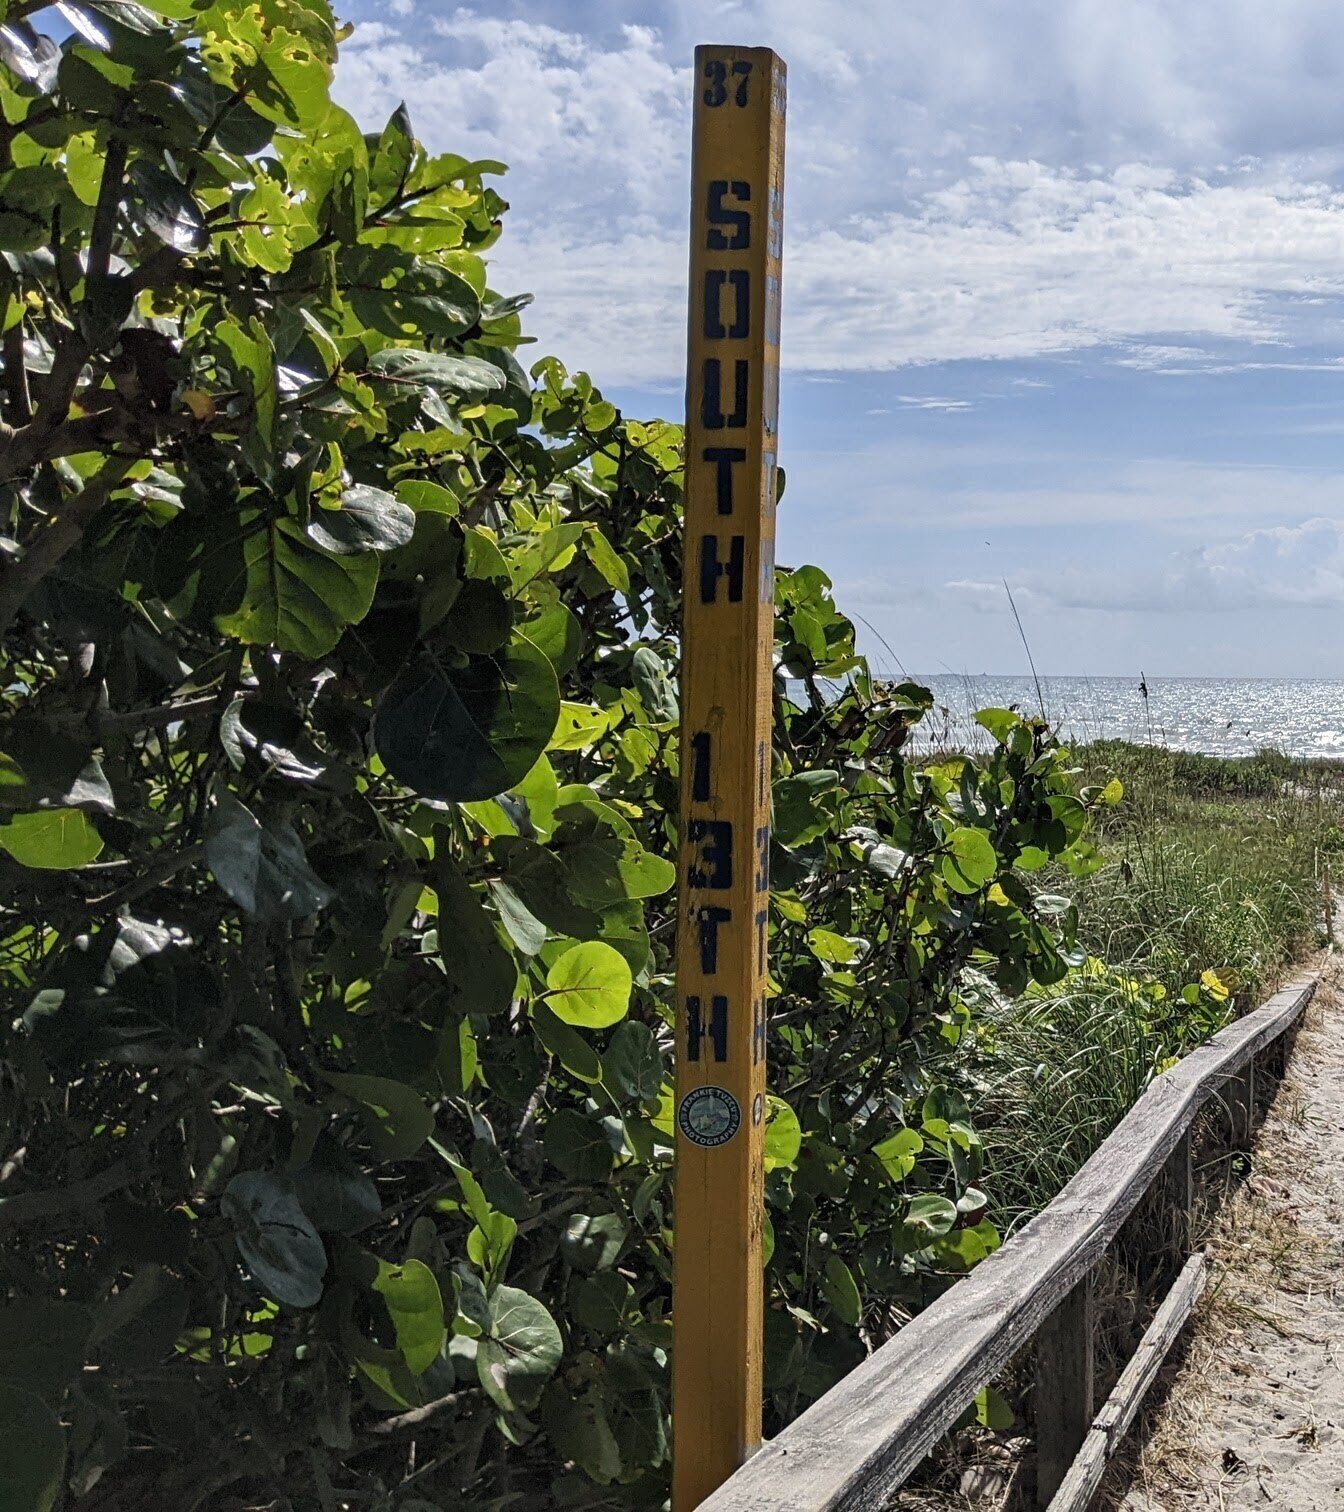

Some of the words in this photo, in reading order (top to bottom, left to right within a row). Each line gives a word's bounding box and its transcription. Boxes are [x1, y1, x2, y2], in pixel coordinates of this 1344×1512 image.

[703, 59, 753, 108] 37
[701, 180, 751, 604] SOUTH
[687, 731, 733, 1063] 13TH
[681, 1121, 738, 1145] PHOTOGRAPHY
